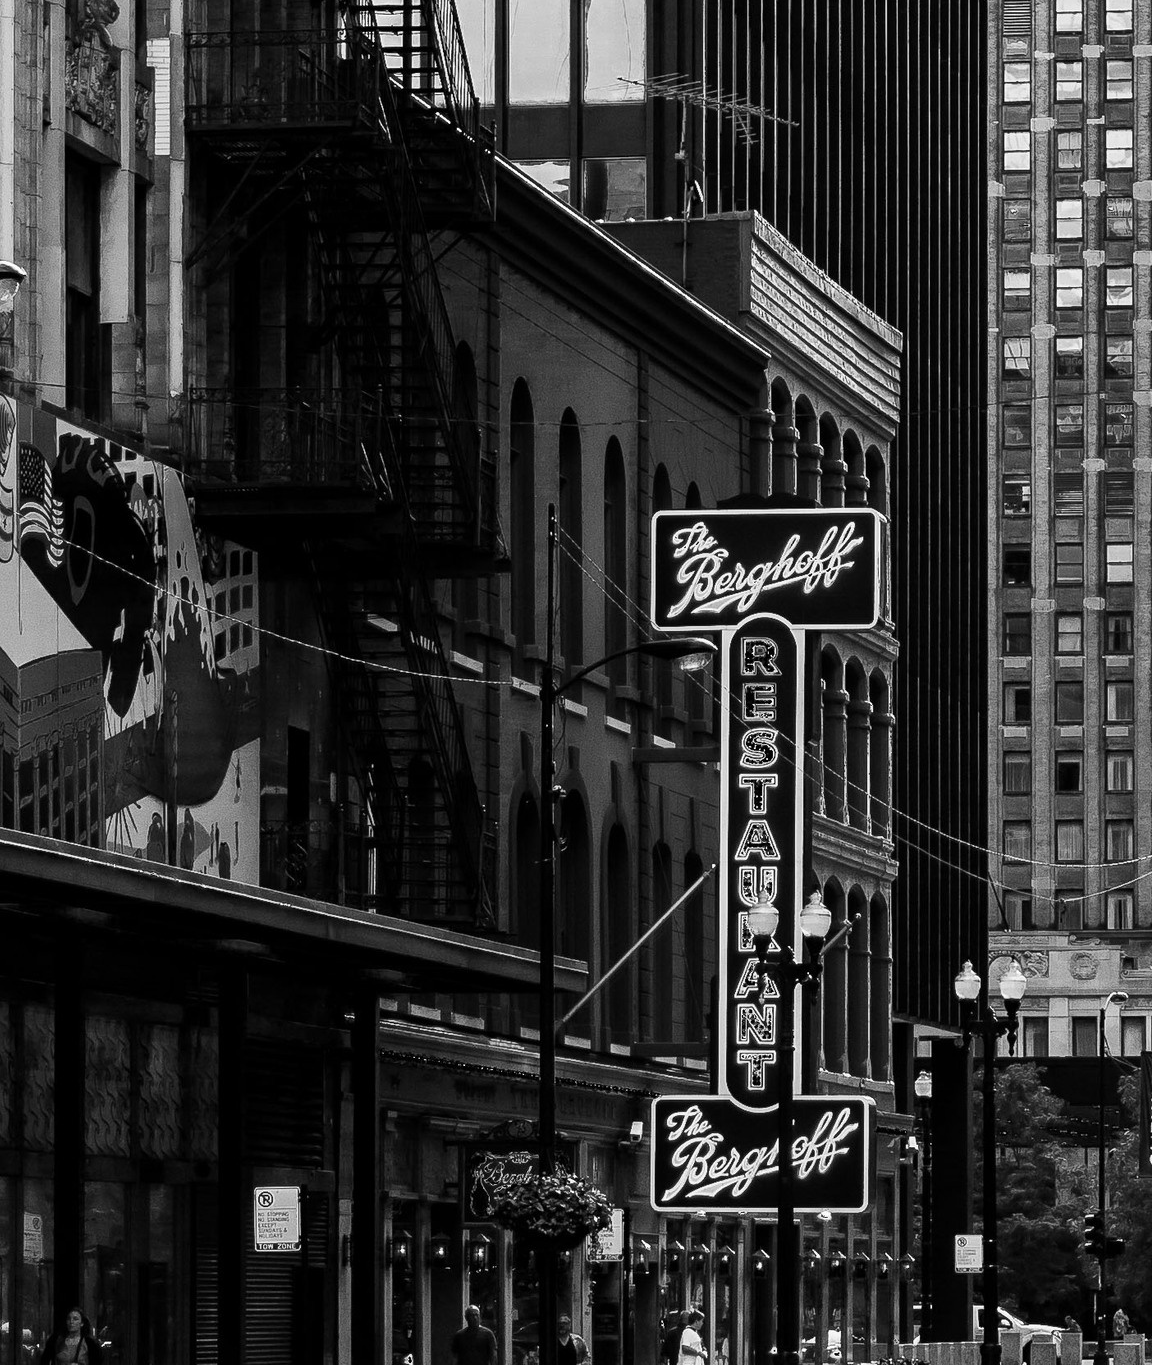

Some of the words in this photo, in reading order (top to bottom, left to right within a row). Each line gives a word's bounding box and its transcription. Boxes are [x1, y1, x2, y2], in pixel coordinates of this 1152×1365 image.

[672, 522, 718, 558] The
[667, 522, 863, 618] Berghoff
[666, 1105, 712, 1141] The
